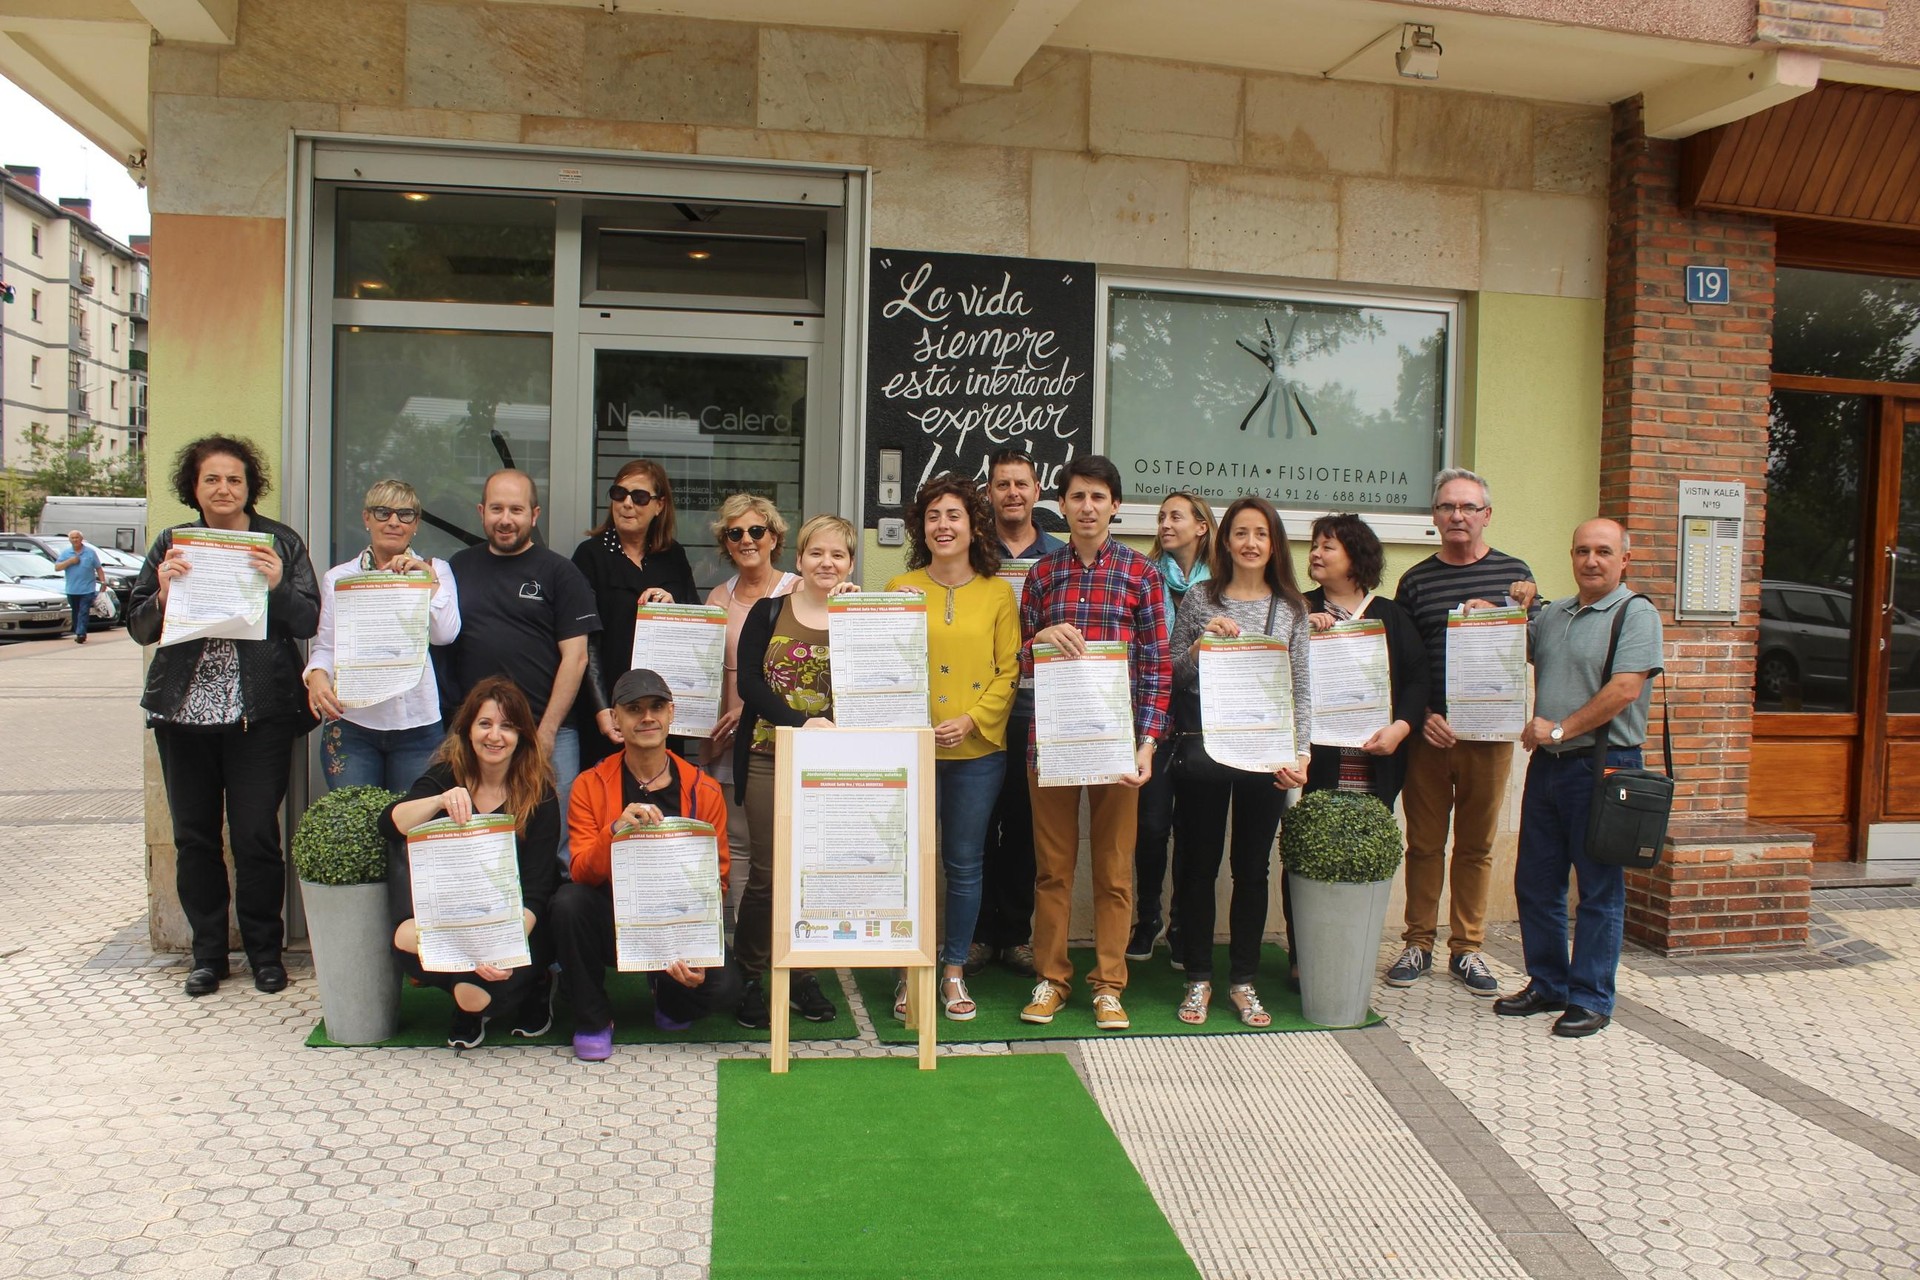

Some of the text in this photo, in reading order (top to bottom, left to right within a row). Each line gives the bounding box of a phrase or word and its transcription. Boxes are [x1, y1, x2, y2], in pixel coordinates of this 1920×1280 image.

[883, 262, 1033, 322] La vida
[1696, 271, 1721, 298] 19
[914, 324, 1060, 371] siempre
[881, 363, 961, 399] está
[607, 402, 791, 432] Noelia Calero
[907, 401, 1079, 457] expresar
[1134, 458, 1408, 485] OSTEOPATIA FISIOTERAPIA
[1135, 483, 1408, 504] Noelia Calero 943 24 91 26 688 815 089
[1684, 487, 1740, 497] VISTIN KALEA
